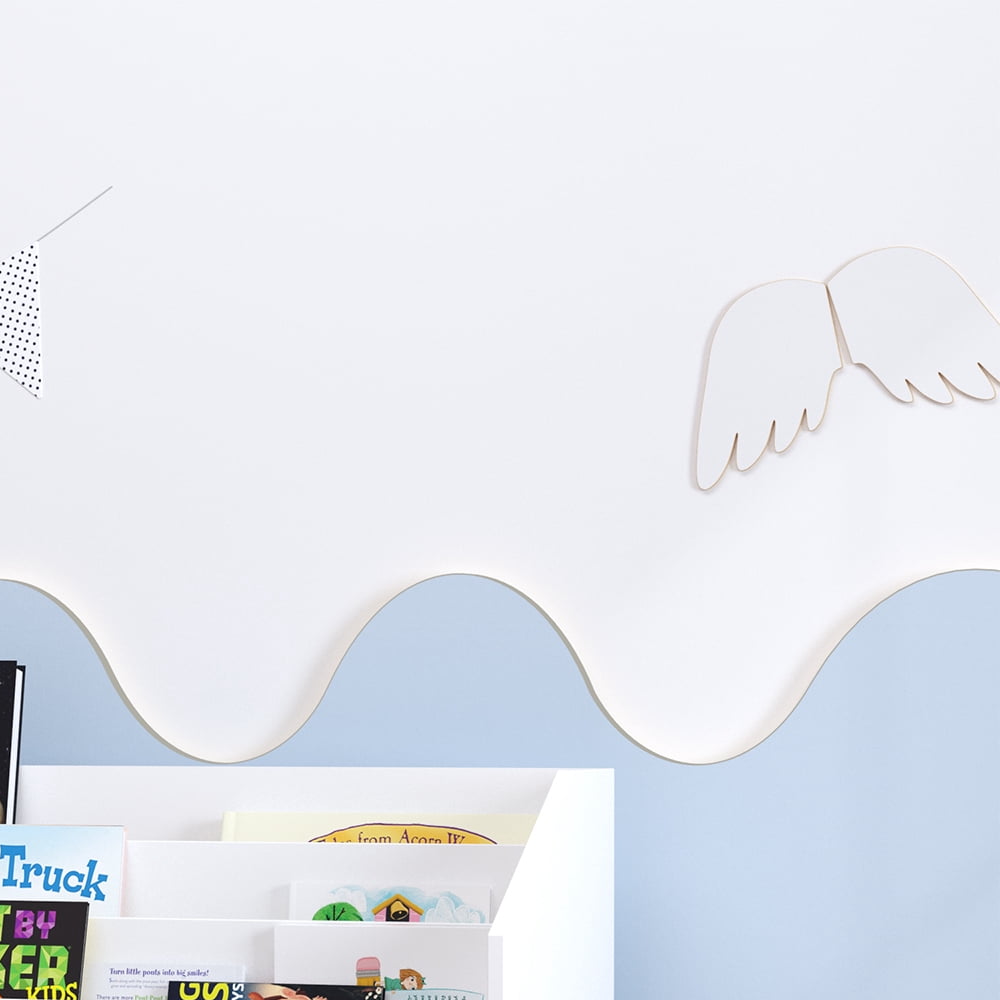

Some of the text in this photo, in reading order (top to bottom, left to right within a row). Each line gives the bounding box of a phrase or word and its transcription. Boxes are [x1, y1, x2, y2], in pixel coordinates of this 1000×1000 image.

[0, 844, 109, 902] Truck
[13, 909, 57, 940] BY
[26, 982, 79, 1000] KIDS
